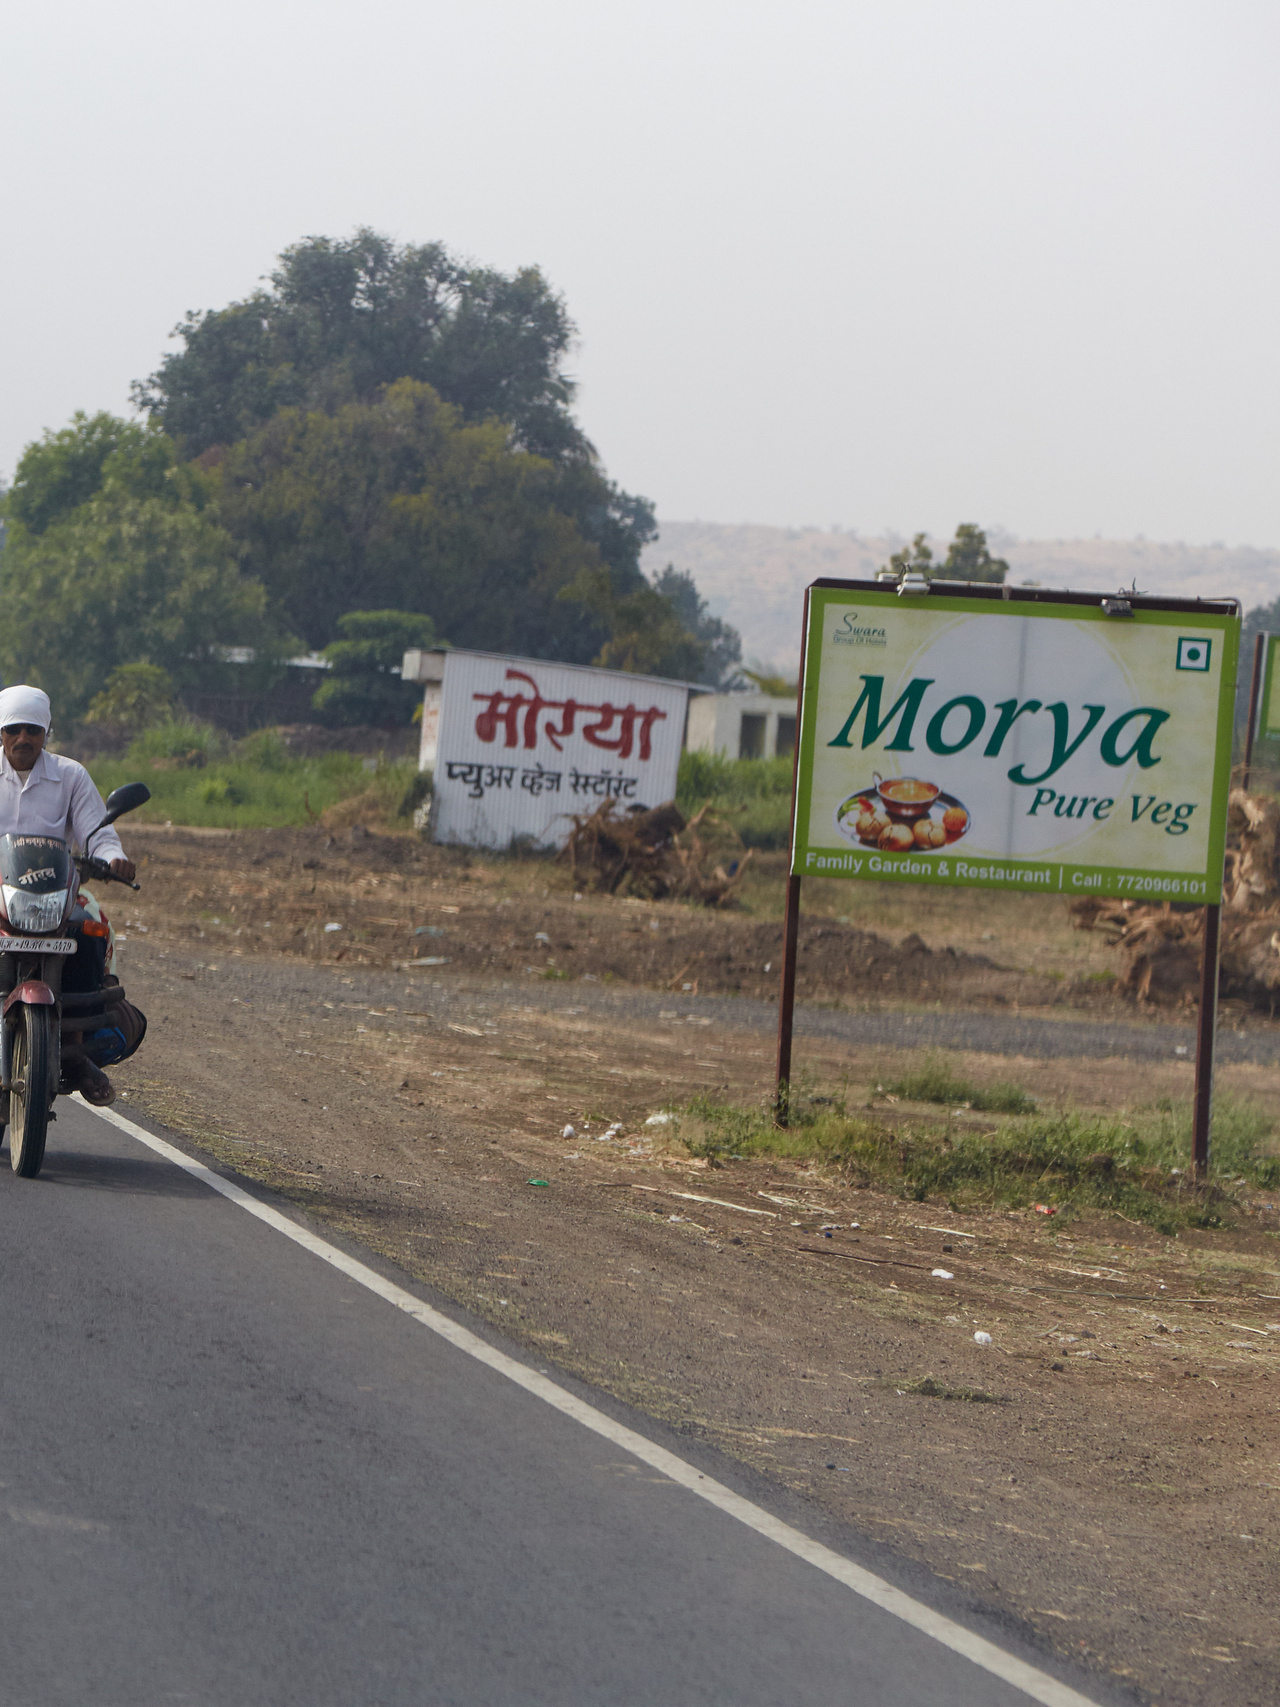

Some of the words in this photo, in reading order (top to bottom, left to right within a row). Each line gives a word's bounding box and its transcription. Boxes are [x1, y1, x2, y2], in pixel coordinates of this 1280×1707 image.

[835, 612, 886, 637] Swara
[472, 668, 668, 761] मोरया
[827, 674, 1171, 786] Morya
[446, 762, 517, 799] प्युअर
[521, 762, 563, 796] व्हेज
[569, 767, 639, 799] रेस्टॉरंट
[1027, 788, 1114, 820] Pure
[1129, 794, 1198, 835] Veg
[806, 852, 863, 873] Family
[868, 856, 931, 875] Garden
[937, 861, 949, 876] &
[955, 862, 1051, 884] Restaurant
[1072, 872, 1102, 888] Call
[1117, 875, 1207, 895] 7720966101
